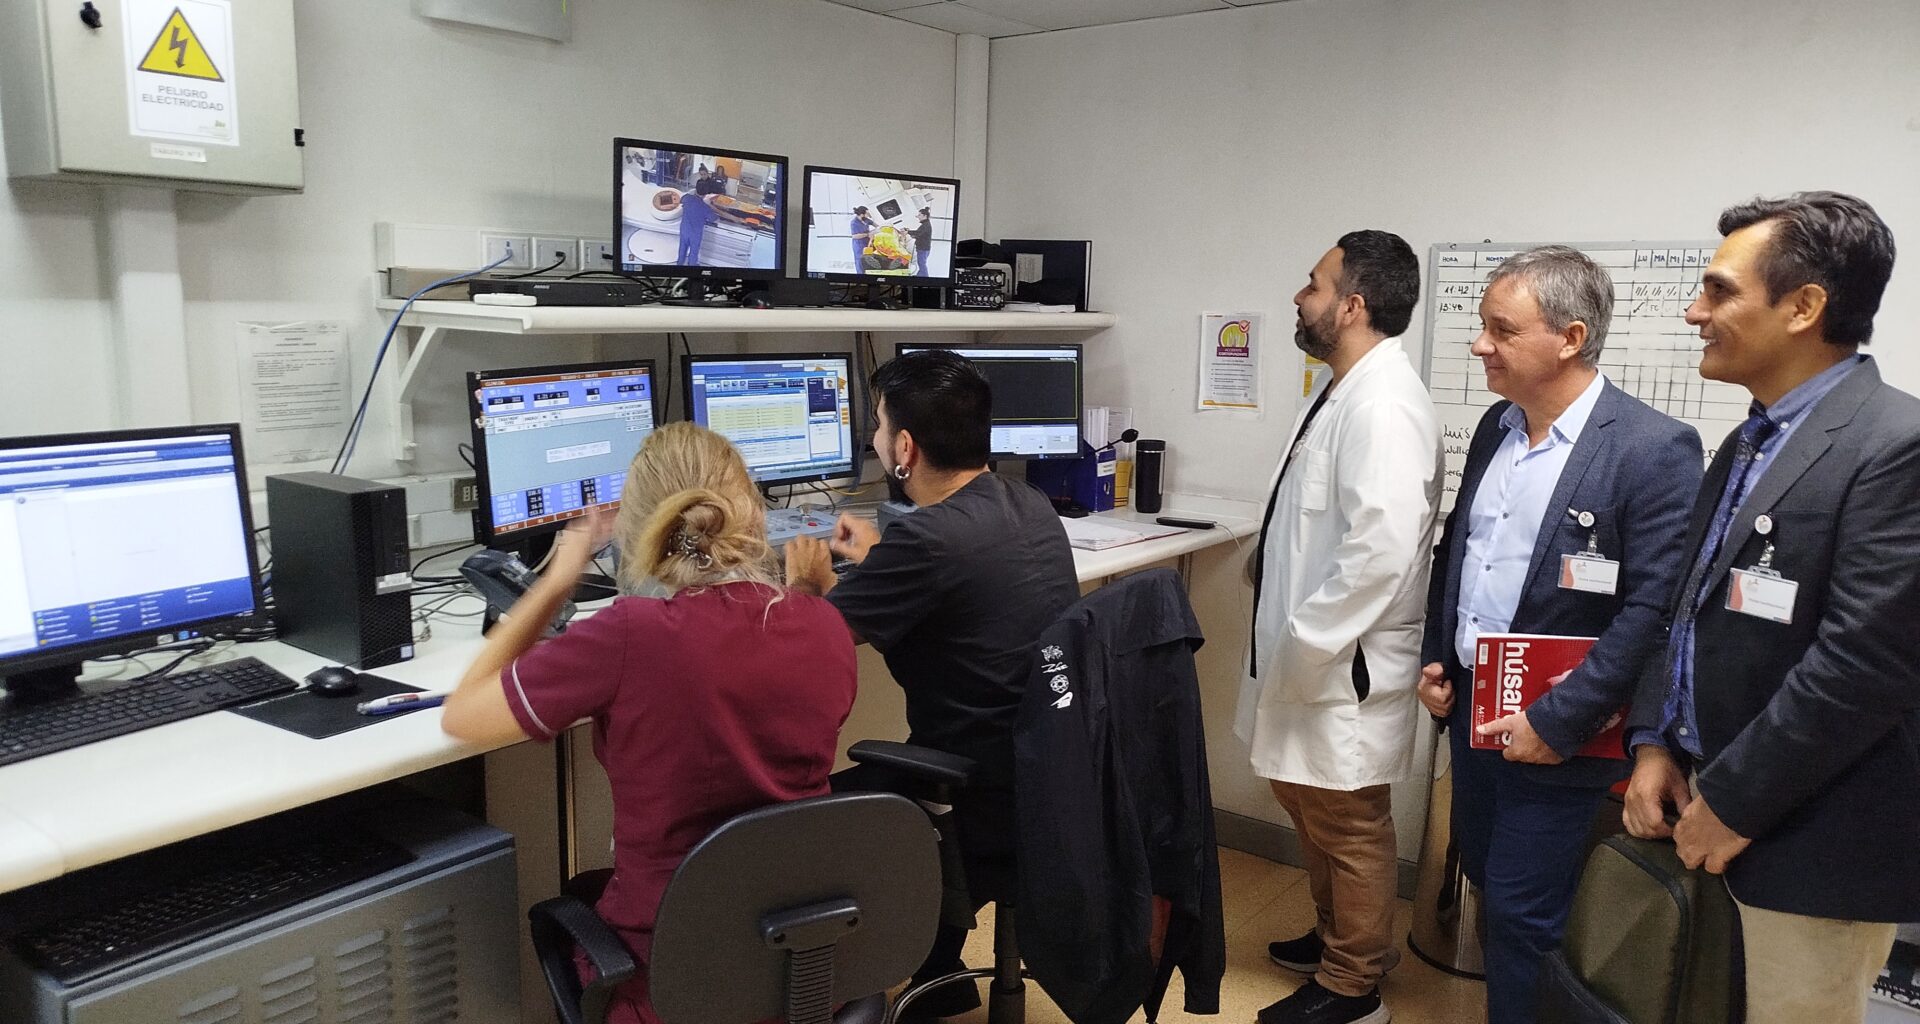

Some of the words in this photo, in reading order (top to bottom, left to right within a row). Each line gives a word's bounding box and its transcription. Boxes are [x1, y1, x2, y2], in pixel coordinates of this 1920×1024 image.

[157, 85, 208, 99] PELIGRO
[142, 93, 224, 111] ELECTRICIDAD
[1443, 424, 1470, 440] Luis
